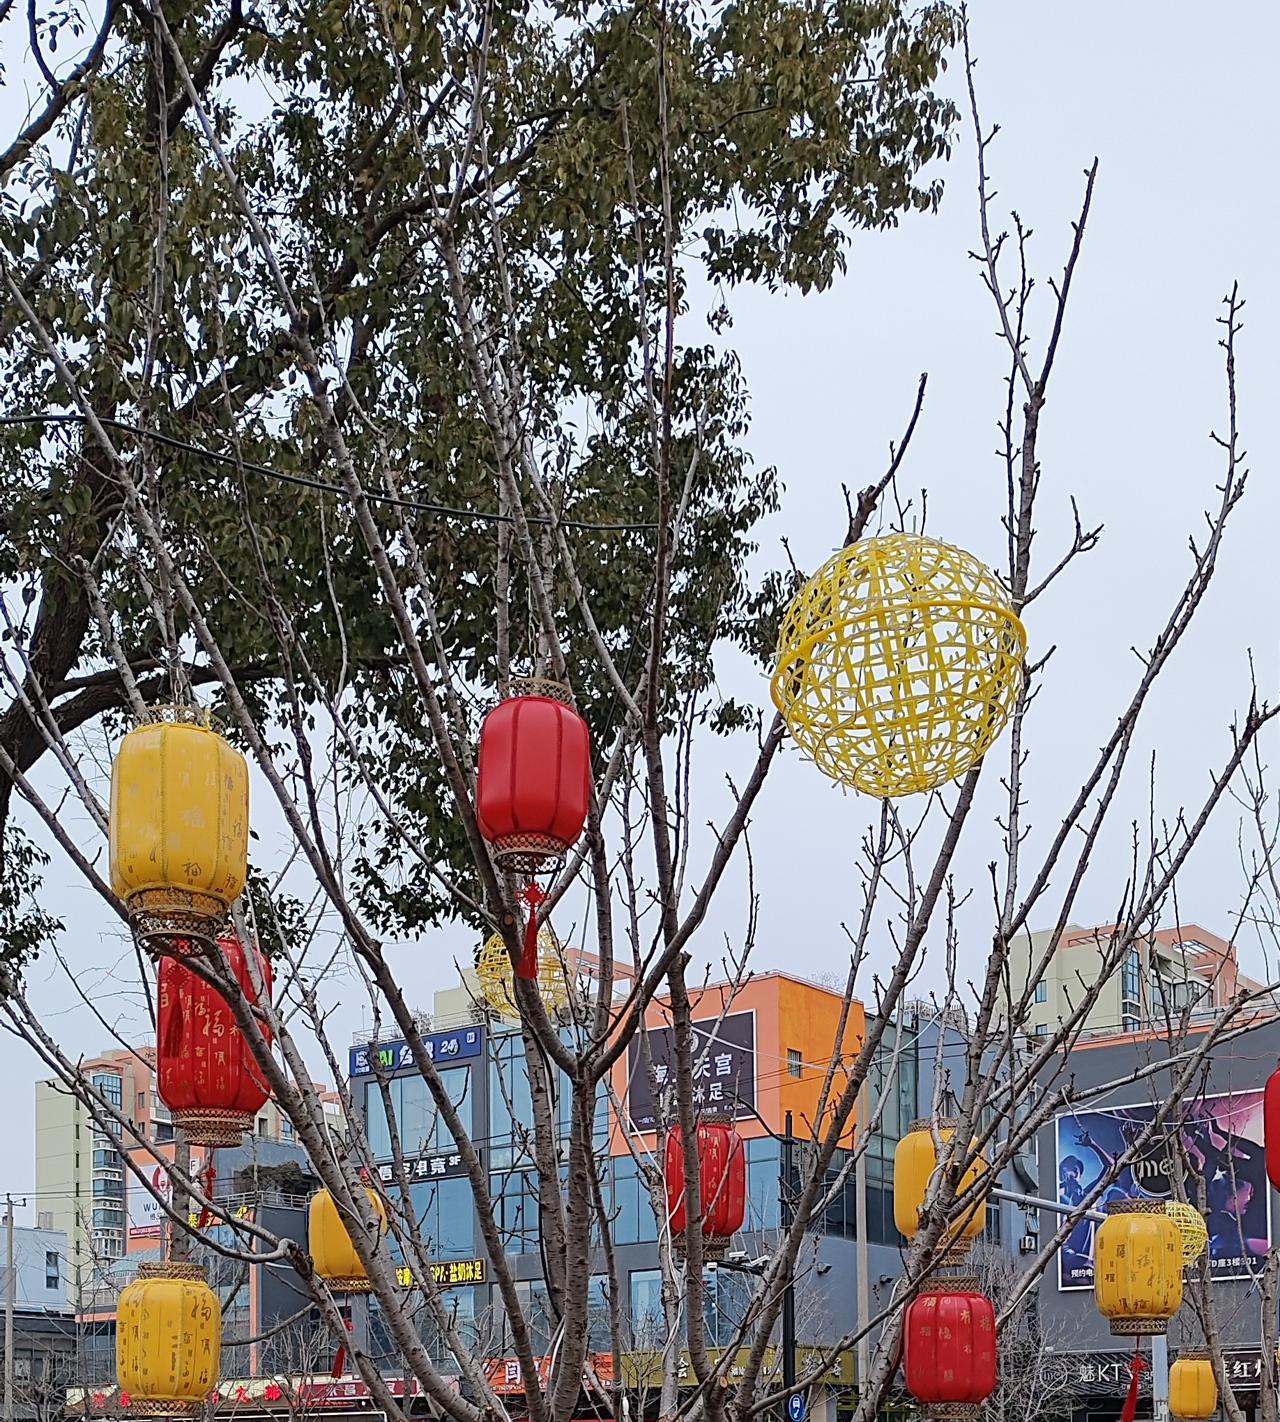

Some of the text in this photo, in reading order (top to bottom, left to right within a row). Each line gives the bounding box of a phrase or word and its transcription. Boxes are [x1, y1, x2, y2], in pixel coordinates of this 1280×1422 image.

[202, 1009, 225, 1038] 福
[653, 1053, 732, 1084] 海天宫
[448, 1155, 461, 1166] 3F
[191, 1291, 212, 1321] 福
